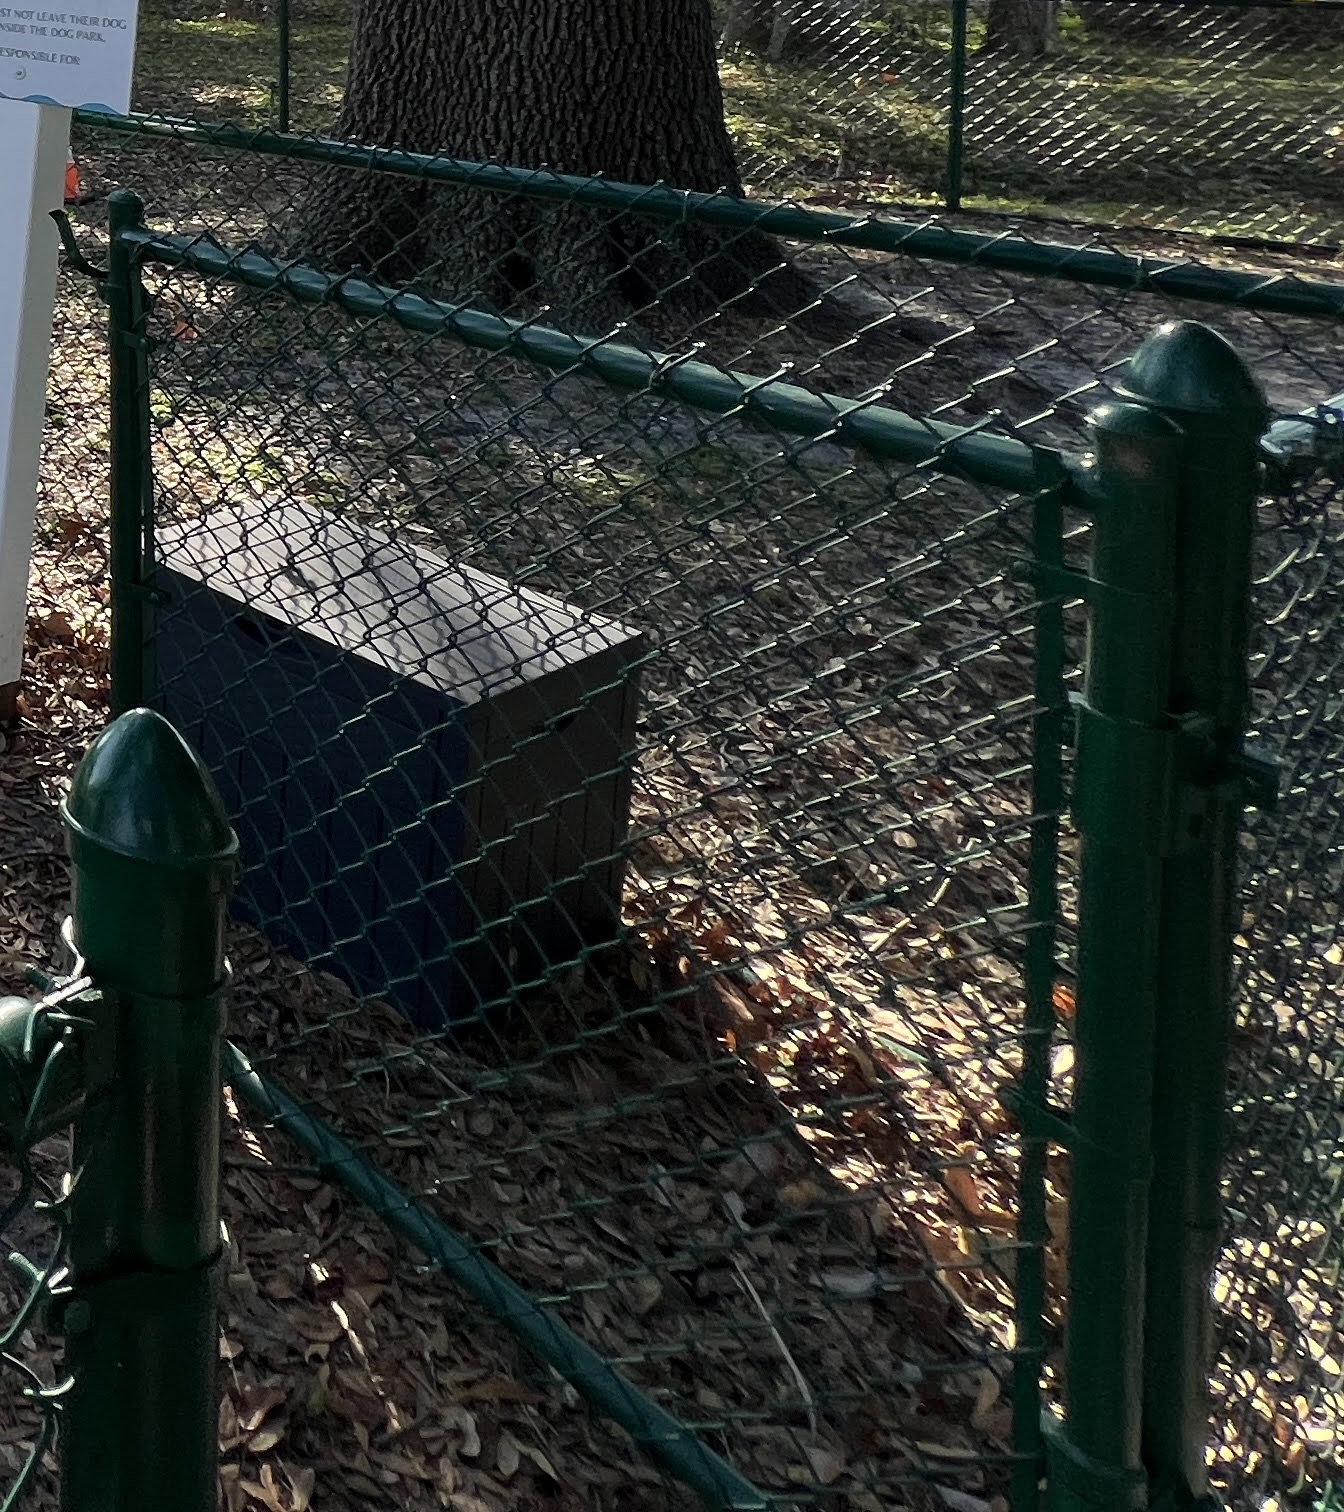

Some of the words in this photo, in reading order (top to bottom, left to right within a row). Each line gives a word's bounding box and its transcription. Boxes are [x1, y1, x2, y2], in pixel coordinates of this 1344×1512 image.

[14, 9, 35, 20] NOT
[37, 12, 67, 23] LEAVE
[70, 15, 99, 26] THEIR
[102, 18, 127, 29] DOG
[29, 25, 48, 36] THE
[51, 28, 74, 39] DOG
[60, 54, 80, 65] FOR
